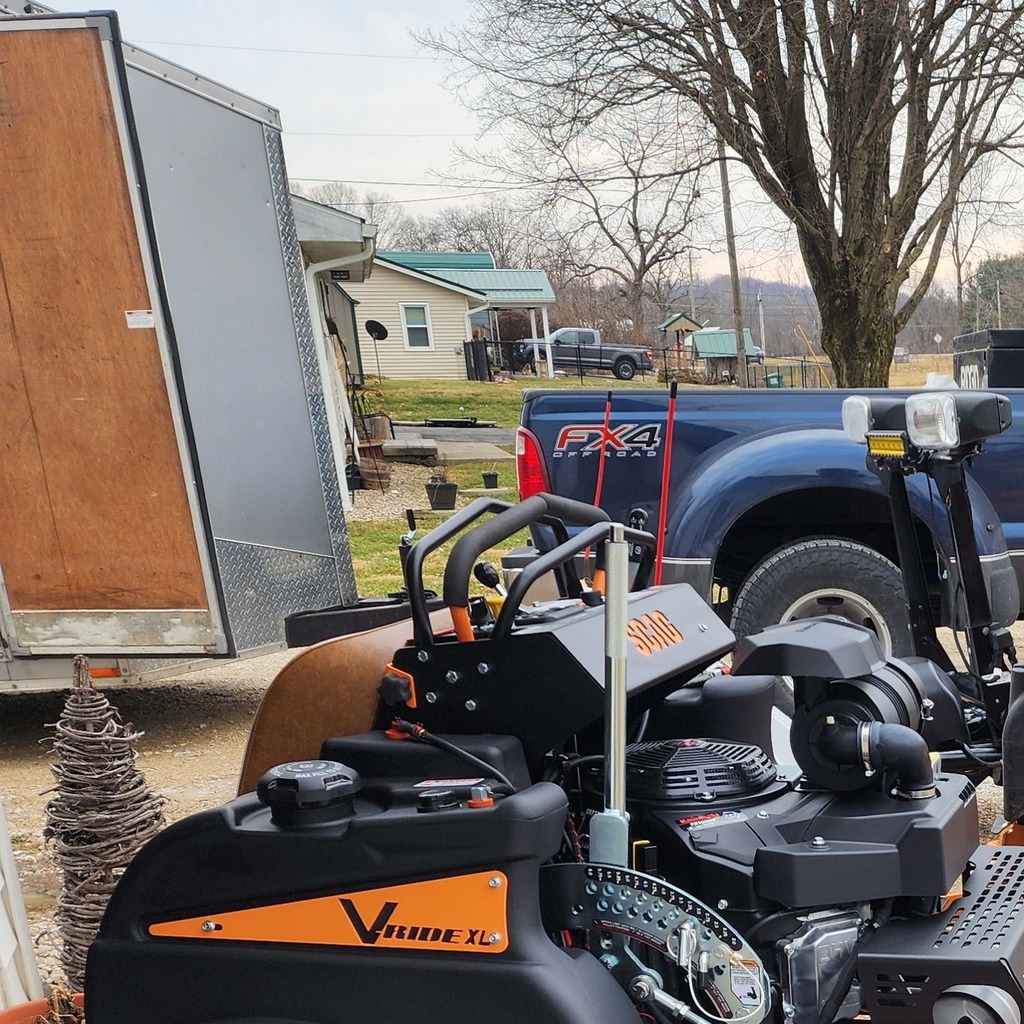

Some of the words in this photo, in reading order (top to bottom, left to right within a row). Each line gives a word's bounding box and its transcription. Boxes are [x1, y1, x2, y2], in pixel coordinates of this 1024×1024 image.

[554, 424, 662, 451] FX4
[627, 610, 684, 656] SCAG
[464, 929, 492, 946] XL
